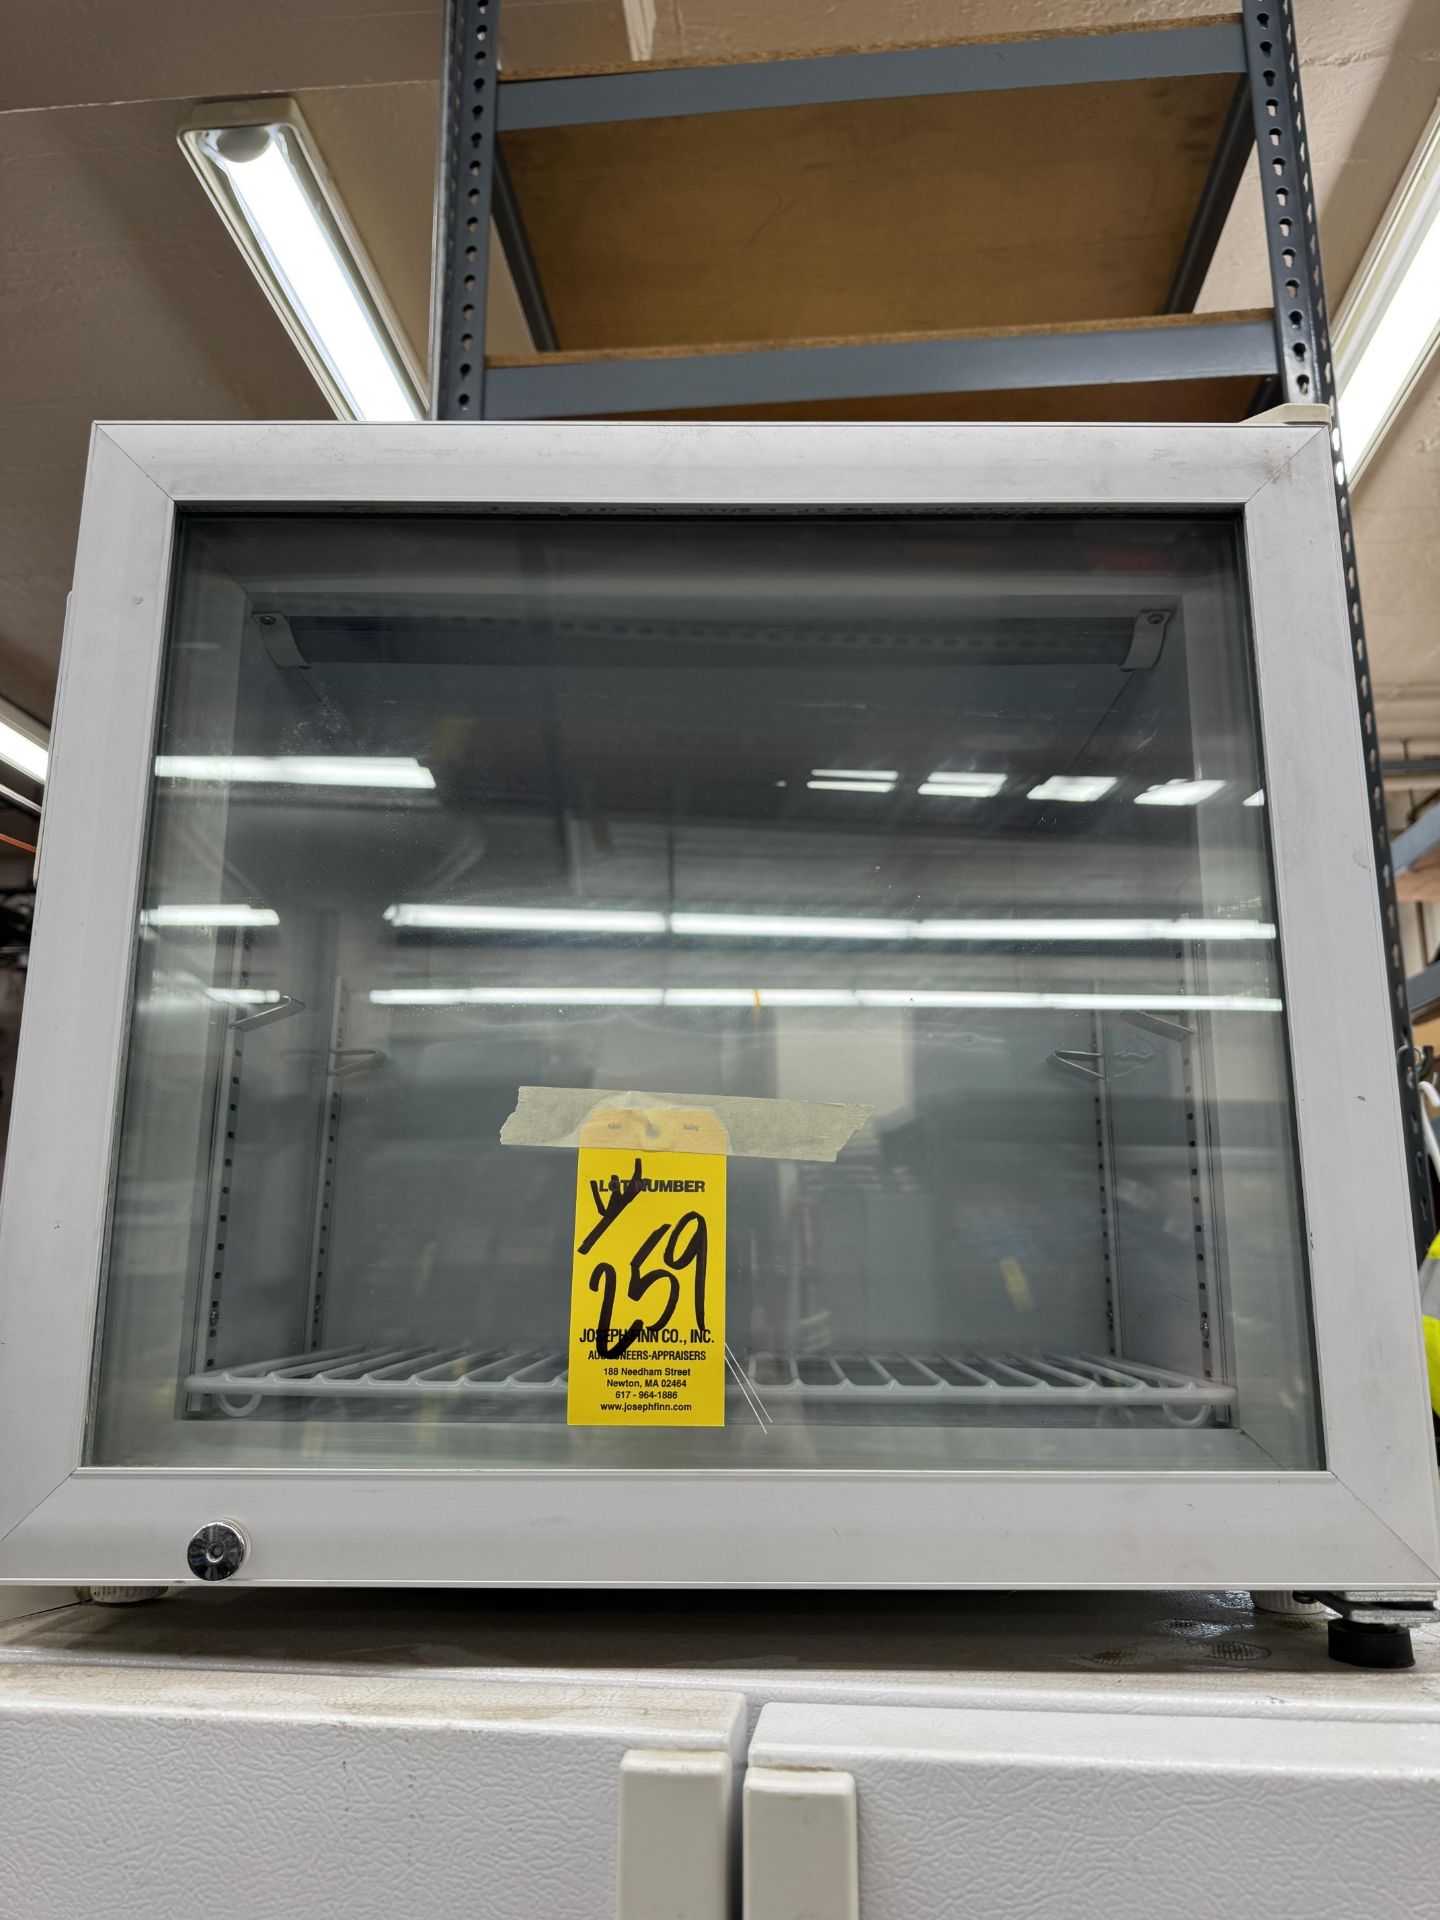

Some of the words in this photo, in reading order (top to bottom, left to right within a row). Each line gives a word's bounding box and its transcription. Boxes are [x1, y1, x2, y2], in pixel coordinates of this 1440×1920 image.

[589, 1211, 708, 1360] 259
[579, 1328, 627, 1344] JOEPH
[630, 1328, 659, 1344] INN
[661, 1328, 687, 1346] CO.,
[690, 1328, 715, 1344] INC.
[588, 1350, 706, 1361] AUNEERS-APPRAISERS
[603, 1367, 619, 1376] 188
[621, 1367, 662, 1376] Needham
[664, 1368, 691, 1377] Street
[606, 1379, 642, 1389] Newton,
[645, 1379, 659, 1388] MA
[661, 1379, 687, 1388] 02464
[615, 1390, 631, 1399] 617
[638, 1390, 678, 1399] 964-1886
[600, 1402, 692, 1412] www.josephfinn.com
